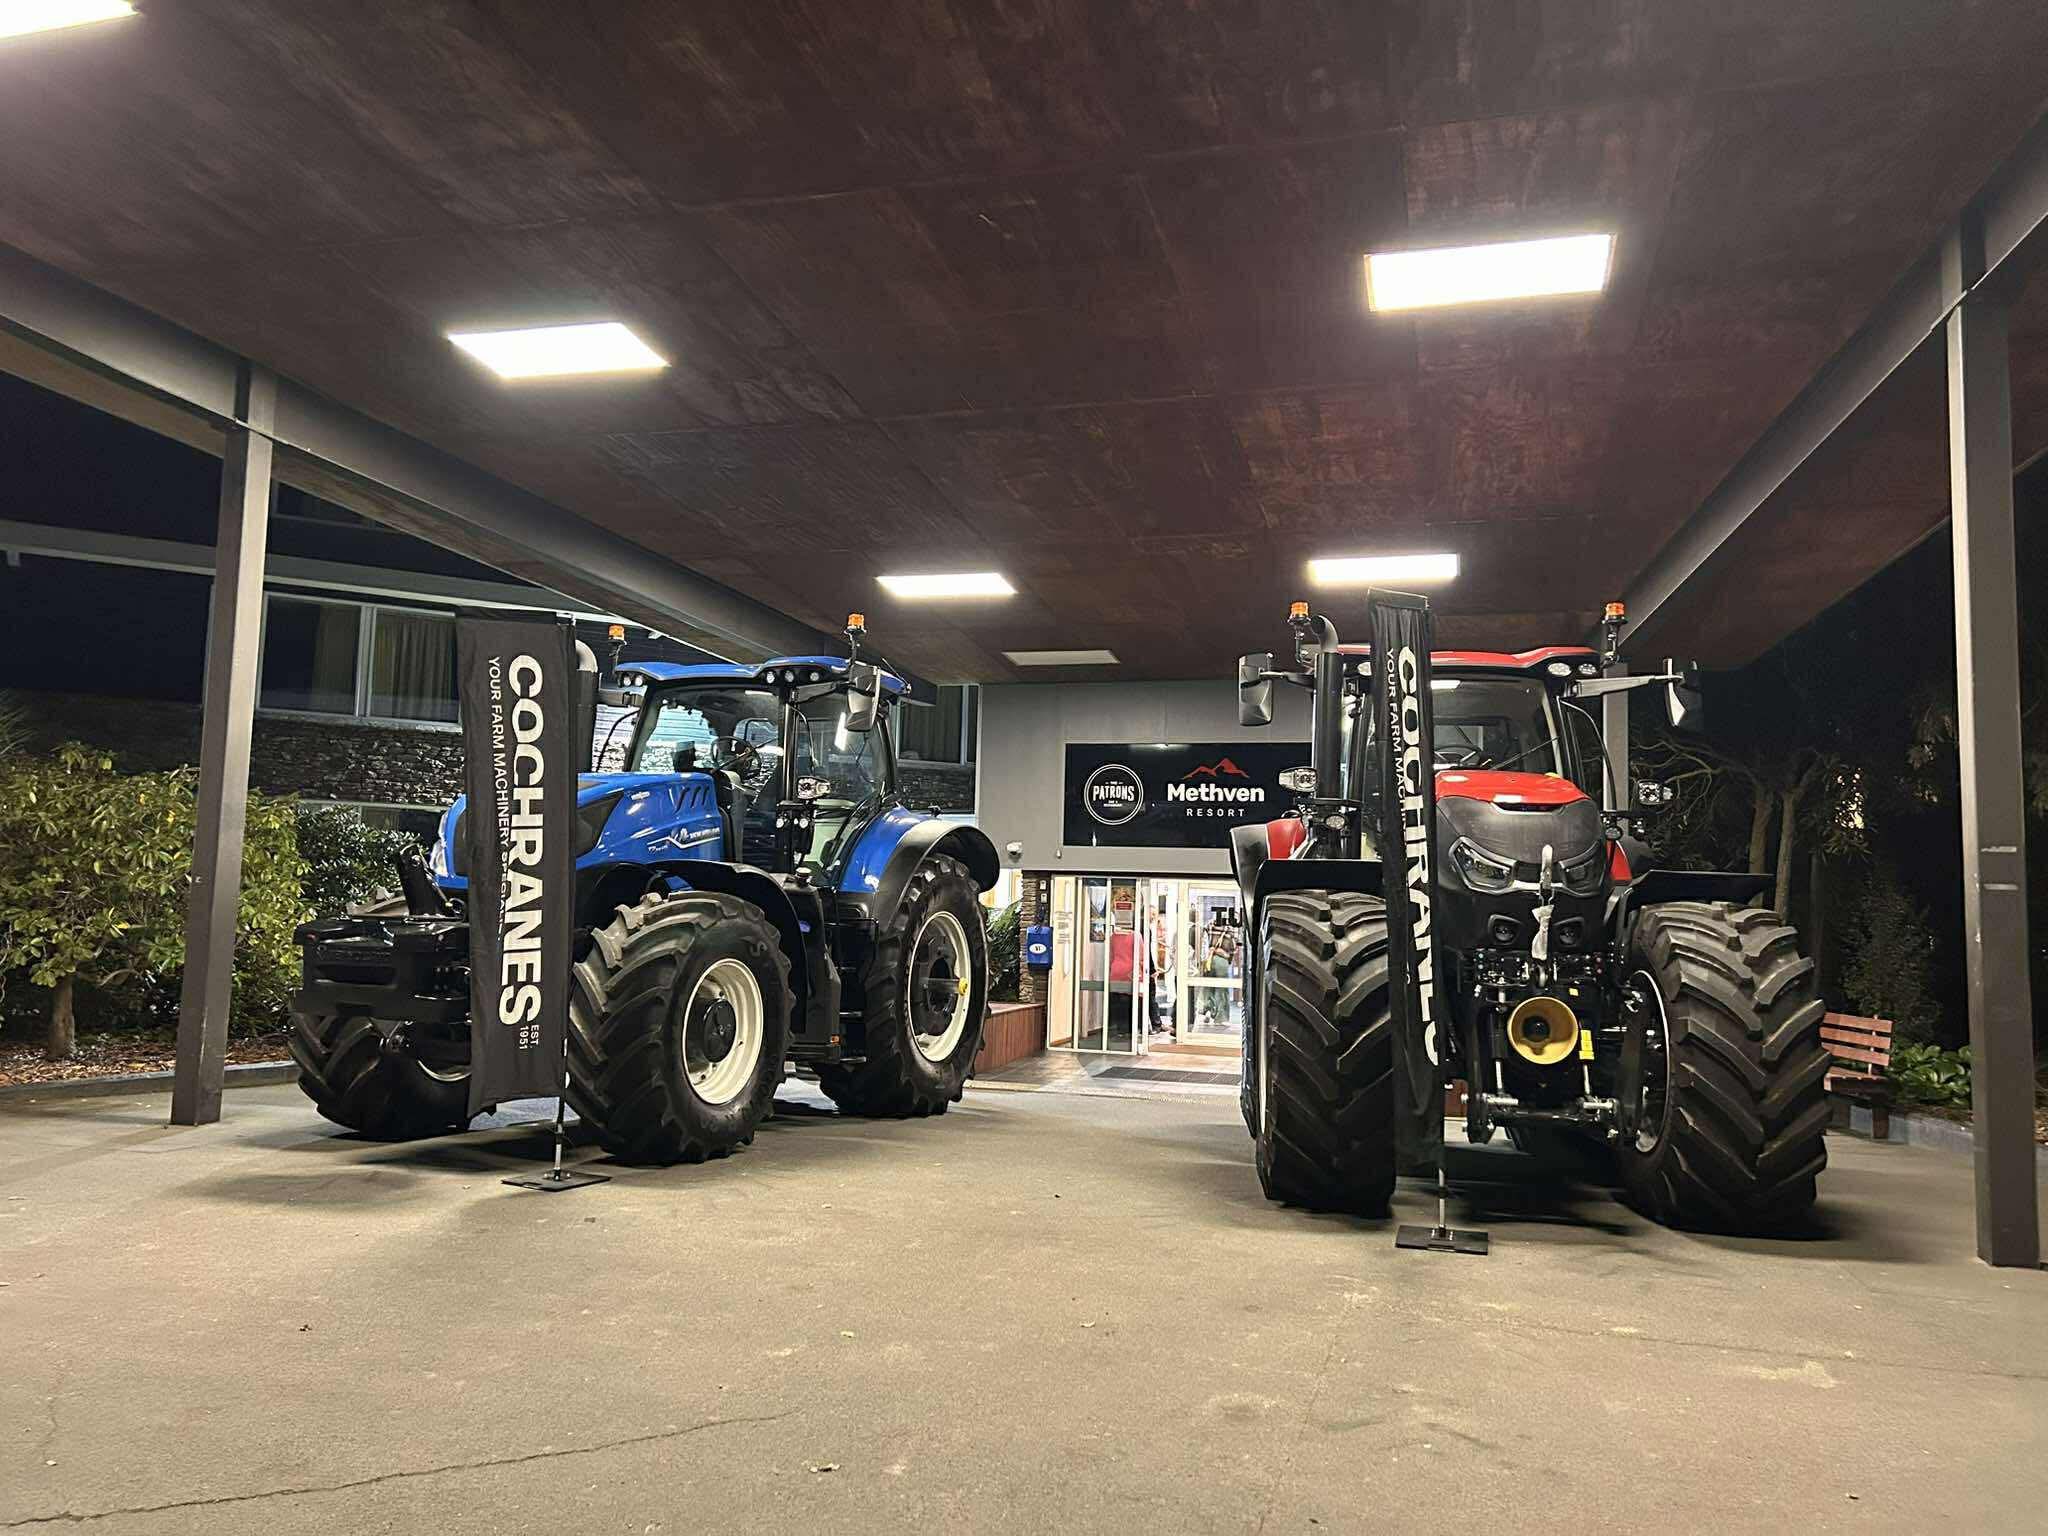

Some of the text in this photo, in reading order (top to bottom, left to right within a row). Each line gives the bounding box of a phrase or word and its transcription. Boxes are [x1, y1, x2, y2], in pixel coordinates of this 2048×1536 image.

[1386, 648, 1396, 697] YOUR
[1389, 702, 1401, 753] FARM
[488, 656, 509, 941] YOUR FARM MACHINERY SPECIALI
[1092, 785, 1135, 802] PATRONS
[1167, 783, 1265, 802] Methven
[1186, 807, 1245, 817] RESORT
[498, 654, 545, 1025] COCHRANES
[518, 1025, 529, 1050] 1951
